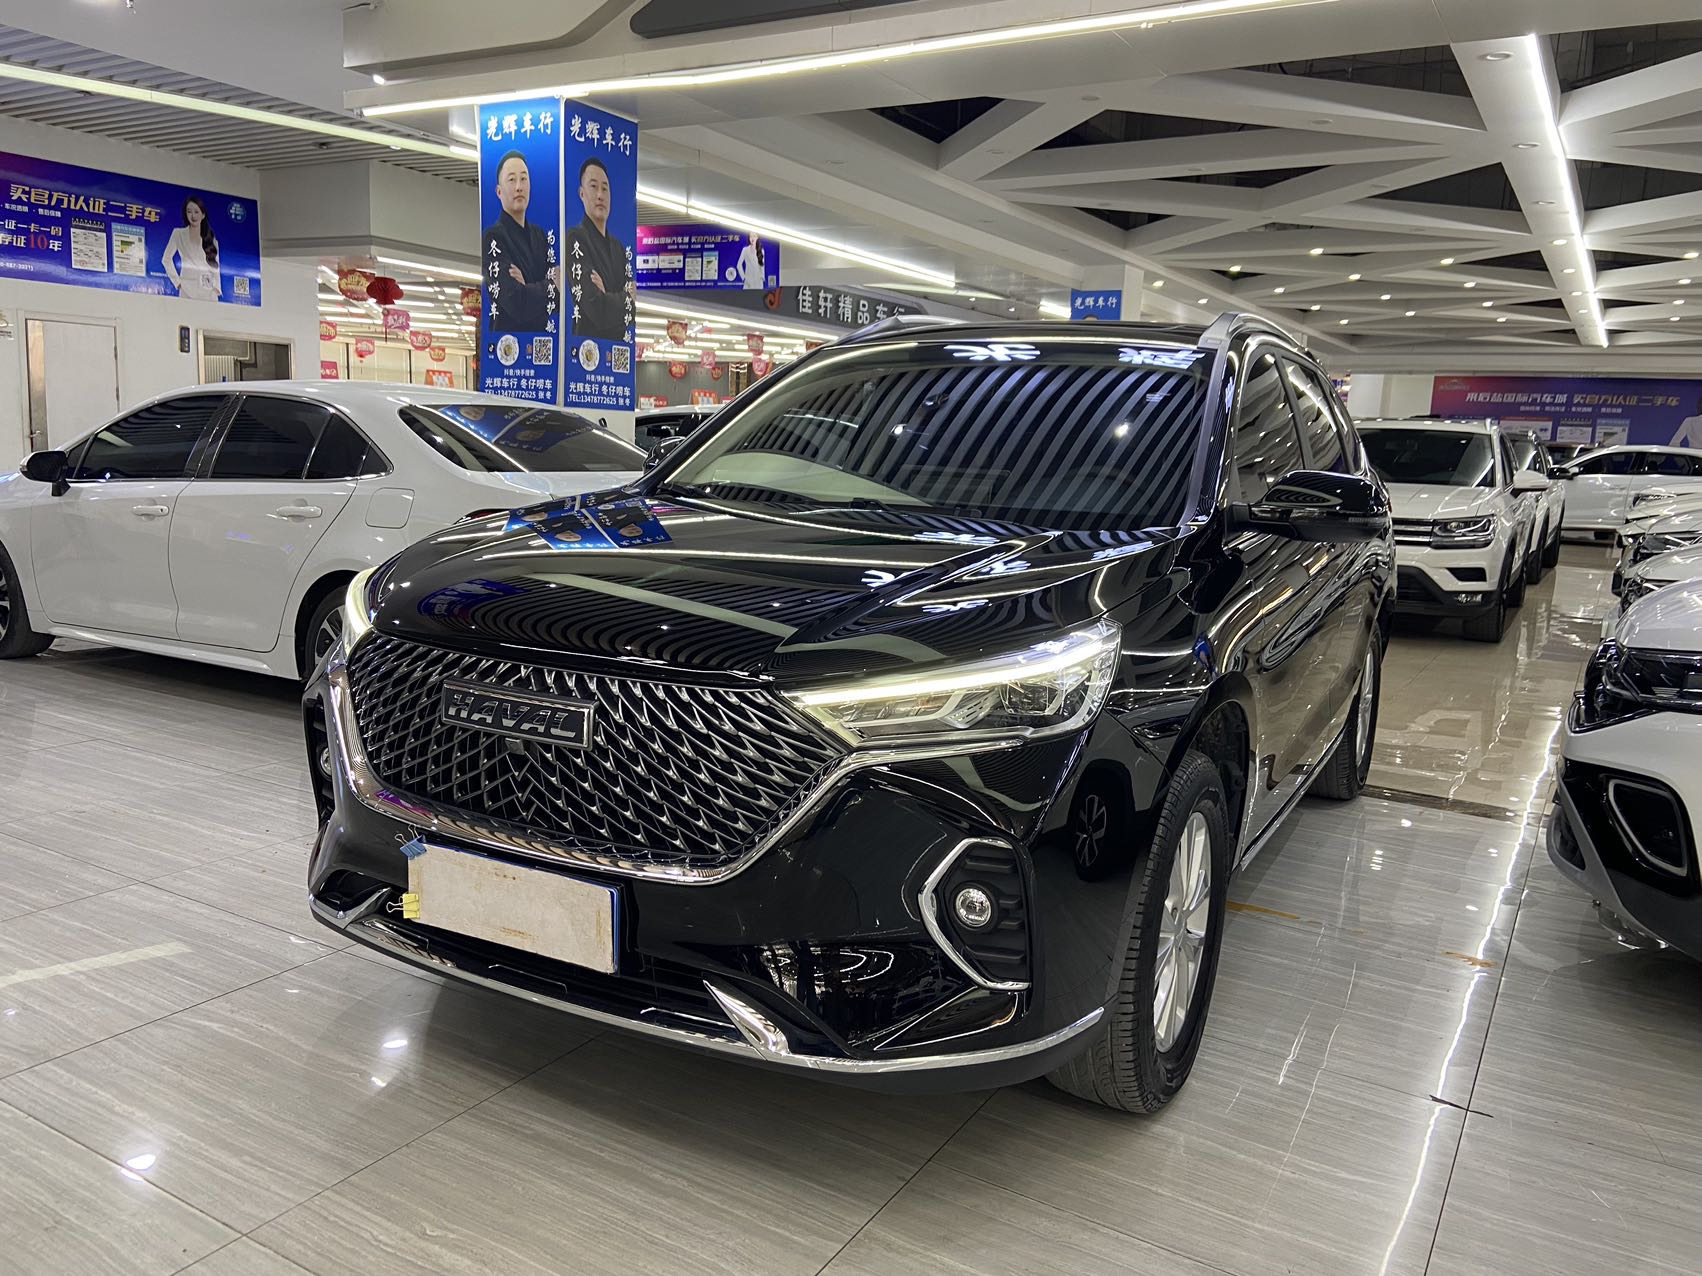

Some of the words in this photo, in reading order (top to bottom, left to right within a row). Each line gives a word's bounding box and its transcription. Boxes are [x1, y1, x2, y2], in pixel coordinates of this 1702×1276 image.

[486, 111, 554, 141] 光辉车行
[570, 114, 632, 157] 光辉车行
[10, 183, 161, 223] 买官方认证二手车
[1074, 296, 1117, 309] 光辉车行
[485, 377, 518, 388] 光辉车行
[569, 382, 598, 394] 光辉车行
[448, 693, 576, 738] HAVAL
